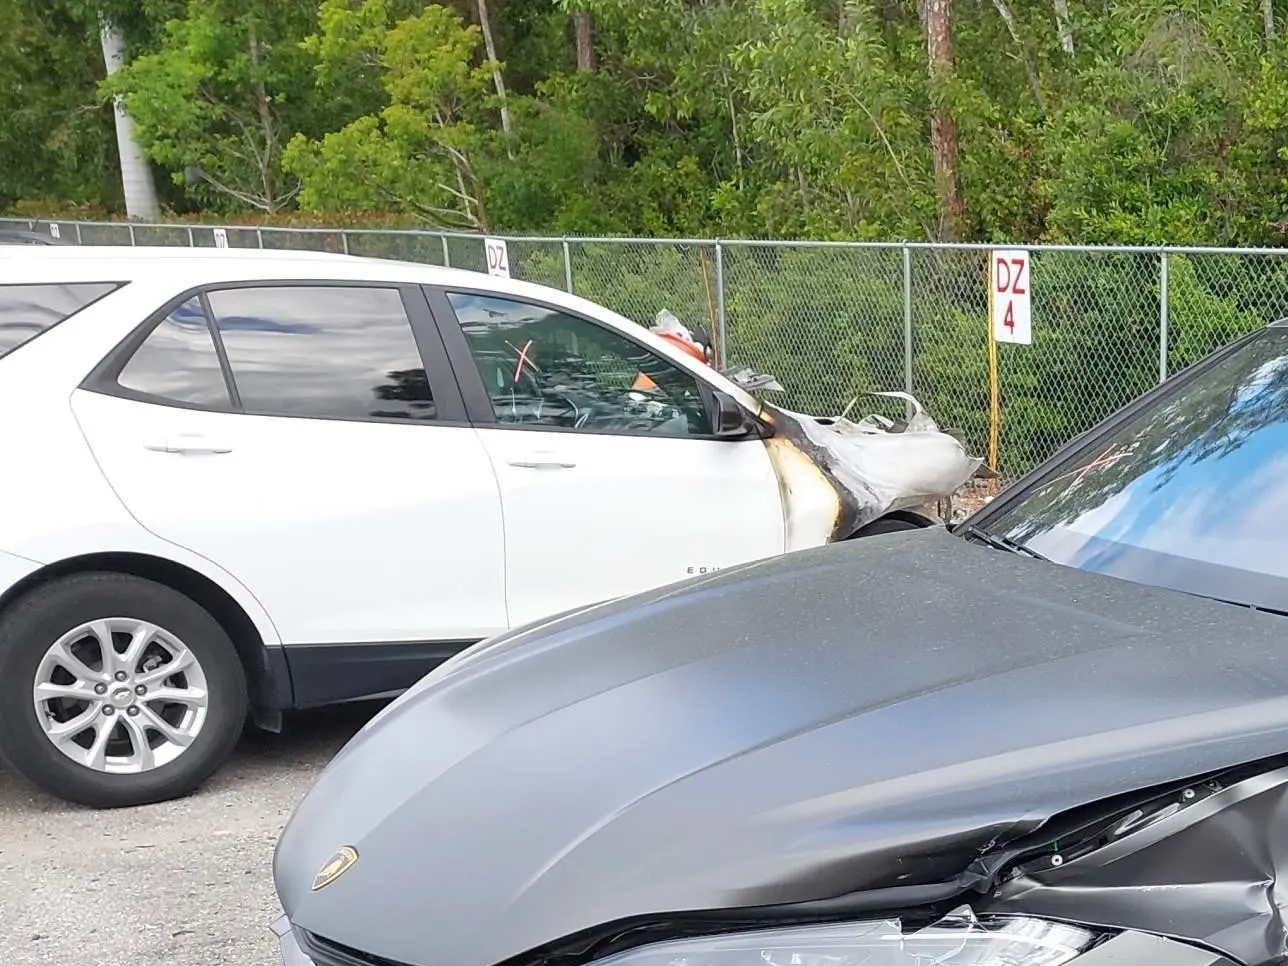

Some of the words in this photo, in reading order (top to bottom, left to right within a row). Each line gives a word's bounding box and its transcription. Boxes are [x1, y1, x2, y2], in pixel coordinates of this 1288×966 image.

[487, 244, 506, 271] DZ
[996, 257, 1026, 295] DZ
[1003, 299, 1016, 335] 4
